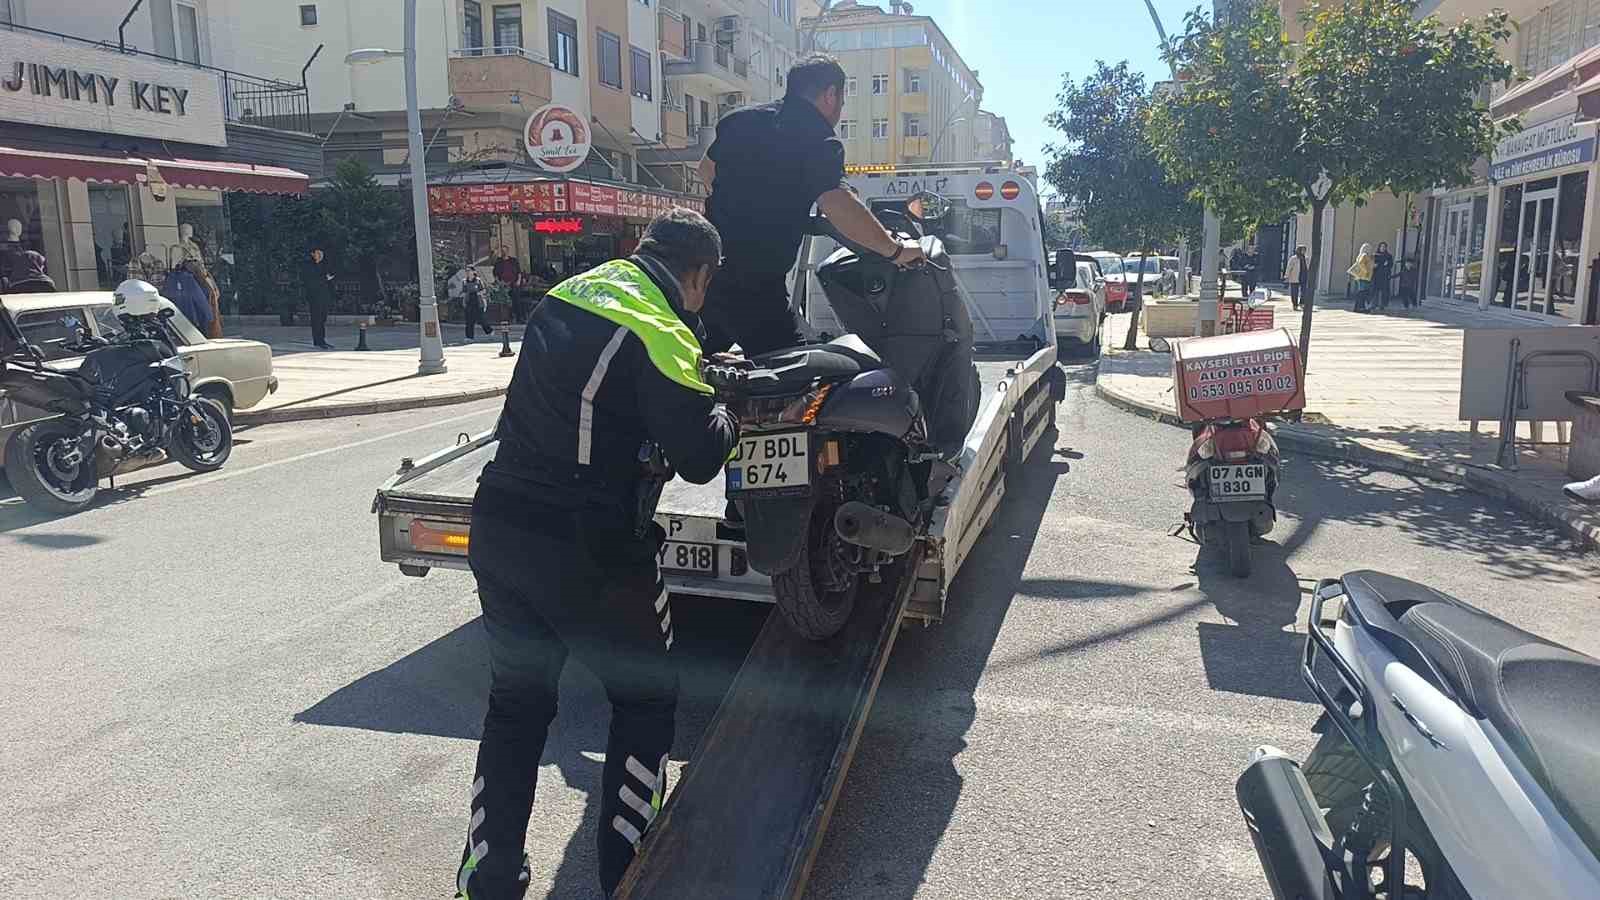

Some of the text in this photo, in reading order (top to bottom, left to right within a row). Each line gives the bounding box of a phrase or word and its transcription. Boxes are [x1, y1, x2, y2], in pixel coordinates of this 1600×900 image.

[3, 61, 189, 116] JIMMY KEY
[1186, 355, 1233, 372] KAYSERİ
[1200, 364, 1280, 381] ALO PAKET
[1190, 376, 1291, 400] 0 553 095 80 02
[764, 437, 805, 460] BDL
[746, 463, 787, 485] 674
[1212, 466, 1263, 480] 07 AGN
[1223, 481, 1251, 493] 830
[676, 544, 711, 569] 818
